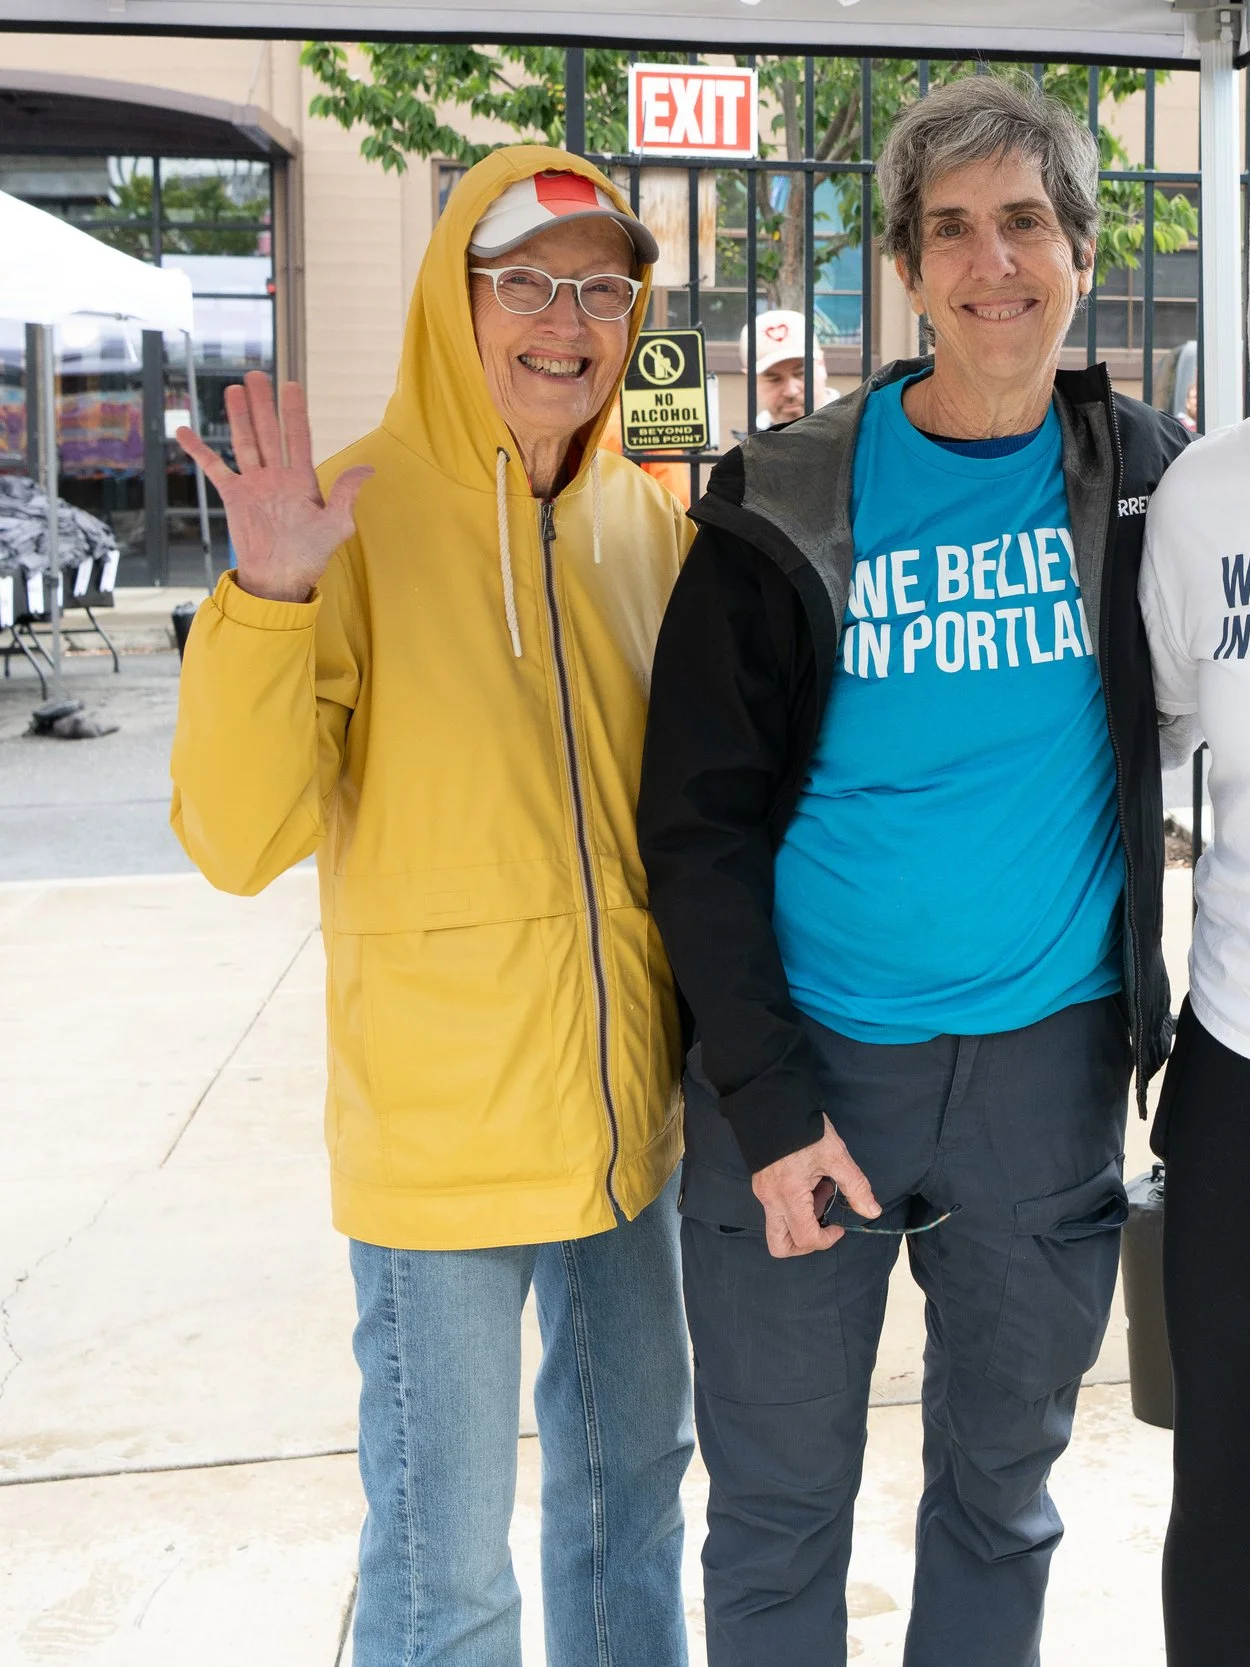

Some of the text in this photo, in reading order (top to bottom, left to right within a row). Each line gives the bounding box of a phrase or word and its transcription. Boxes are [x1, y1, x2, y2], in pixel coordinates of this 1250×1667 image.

[641, 76, 745, 145] EXIT
[654, 393, 673, 407] NO
[631, 408, 699, 423] ALCOHOL
[631, 434, 701, 445] THIS POINT
[639, 426, 693, 436] BEYOND
[1117, 495, 1150, 517] RRE
[849, 549, 926, 619] WE
[844, 620, 891, 679] IN
